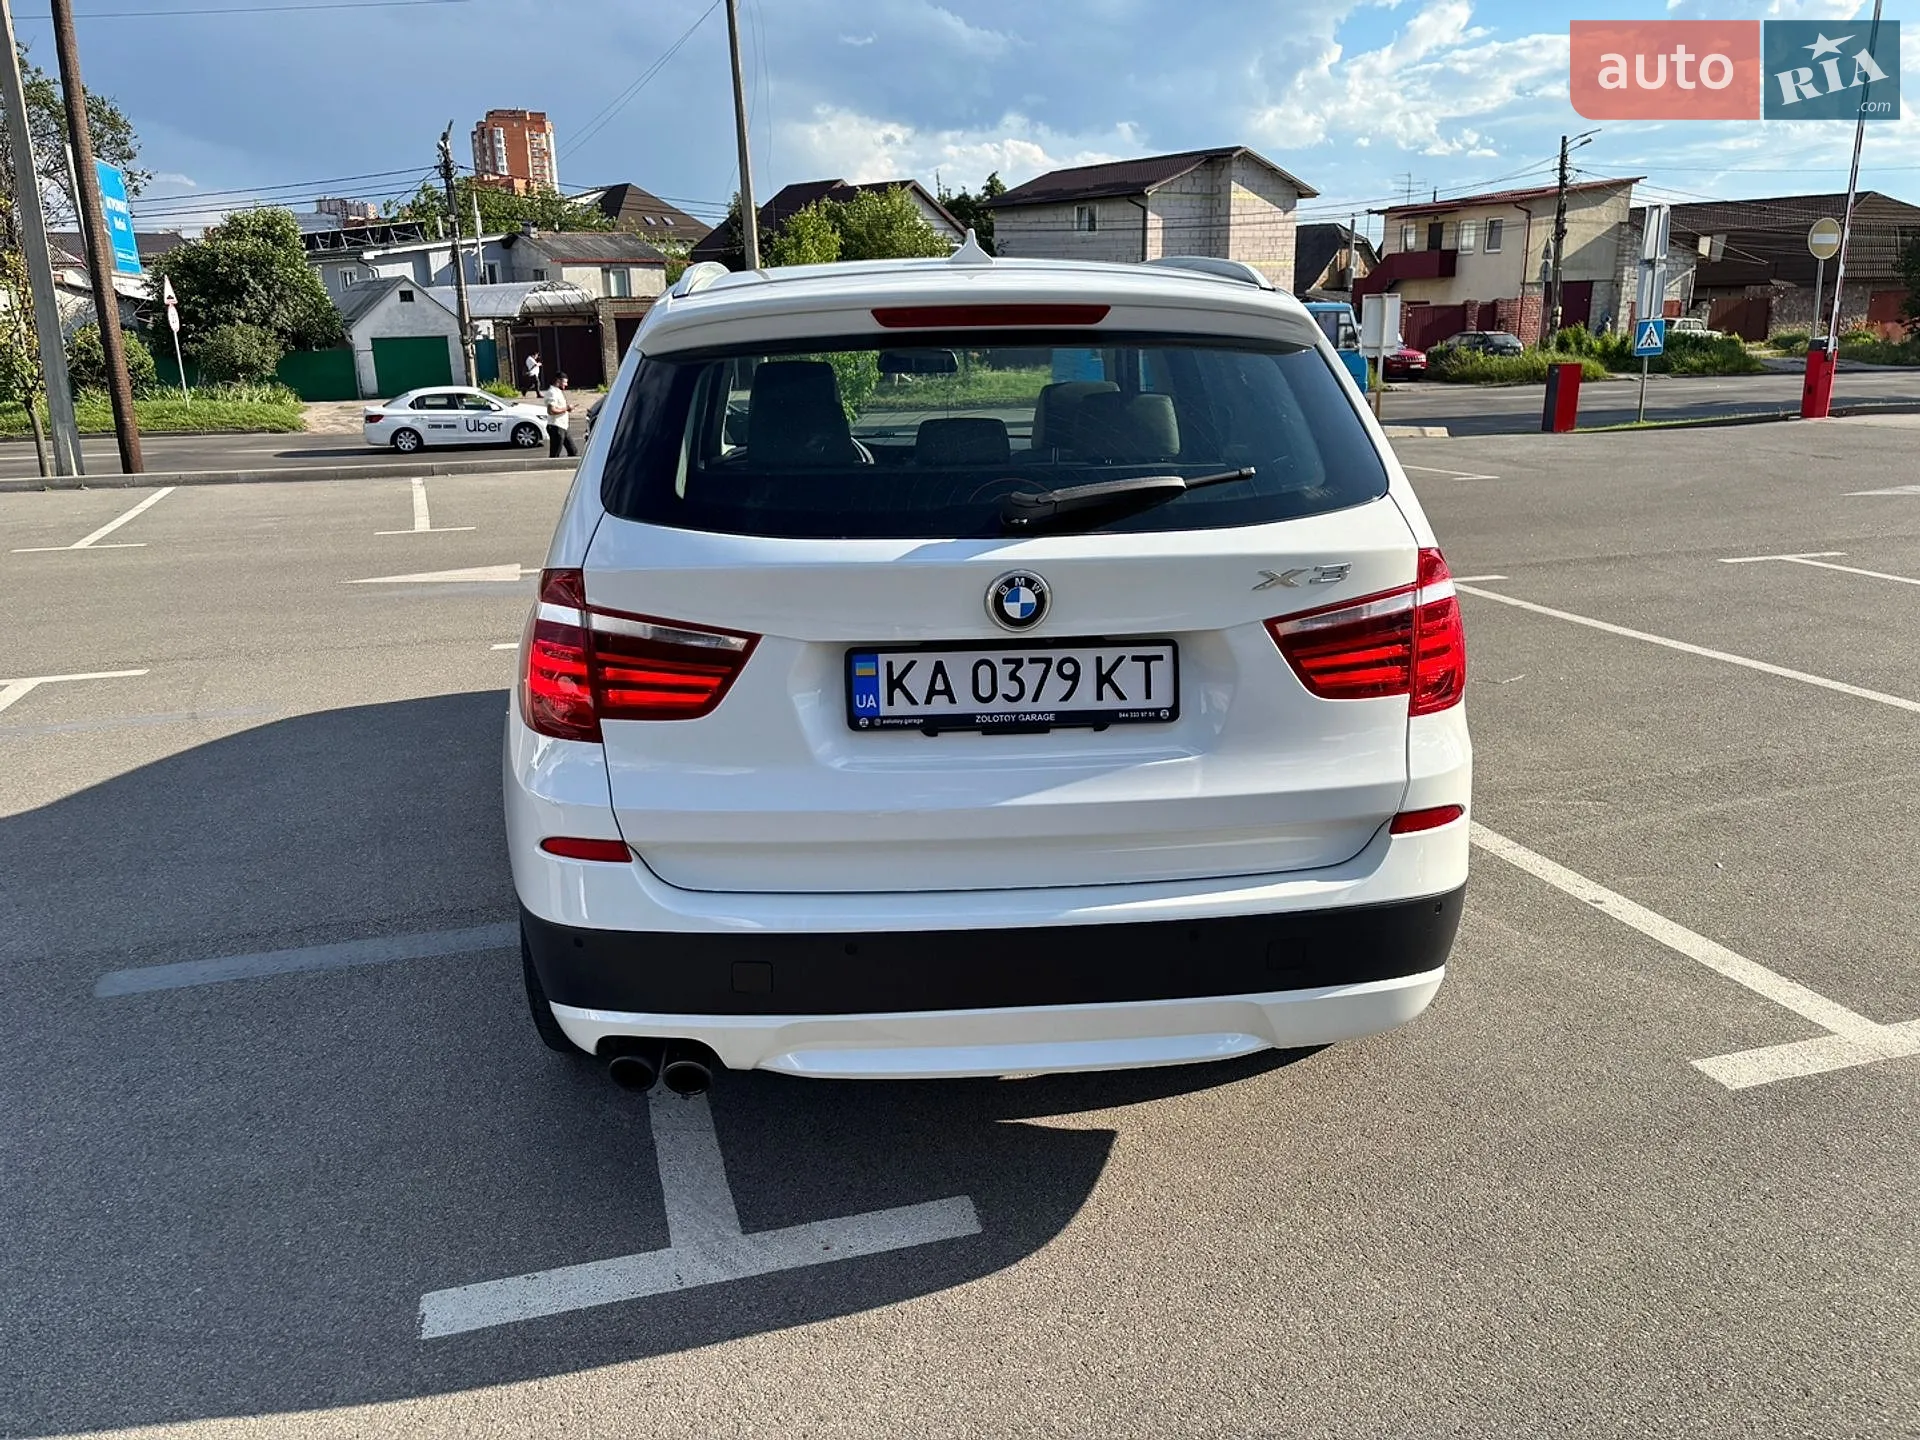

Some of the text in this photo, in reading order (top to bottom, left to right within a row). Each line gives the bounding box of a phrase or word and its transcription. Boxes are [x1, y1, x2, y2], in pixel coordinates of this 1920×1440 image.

[465, 419, 503, 433] Uber
[1251, 562, 1352, 591] X3
[885, 654, 1164, 707] KA 0379 KT
[856, 694, 877, 708] UA
[975, 712, 1055, 724] ZOLOTOY GARAGE
